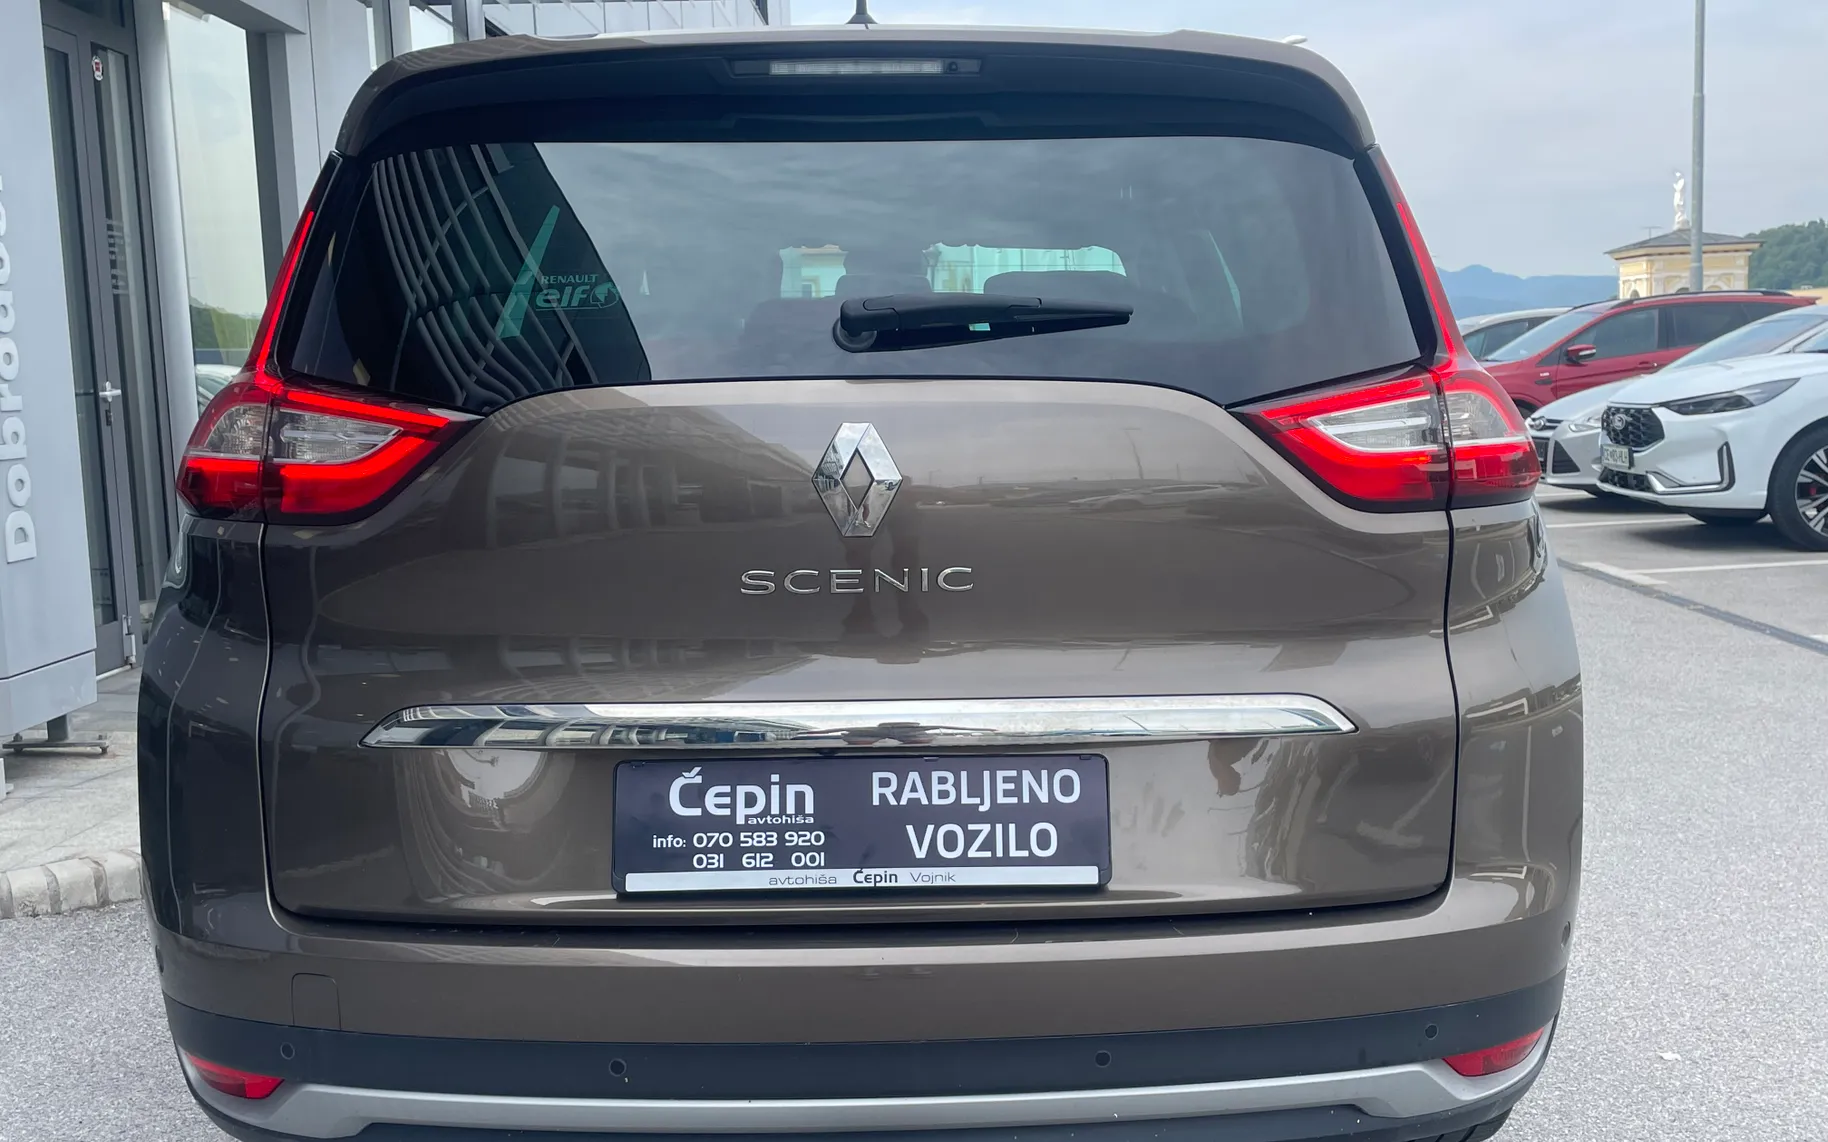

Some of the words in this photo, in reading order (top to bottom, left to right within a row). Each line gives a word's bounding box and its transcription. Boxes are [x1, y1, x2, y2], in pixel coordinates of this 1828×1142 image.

[541, 273, 599, 284] RENAULT
[535, 285, 591, 308] elf
[740, 567, 974, 594] SCENIC
[669, 766, 814, 825] Čepin
[871, 768, 1081, 812] RABLJENO
[747, 814, 815, 825] avtohiša
[652, 834, 687, 848] info:
[693, 832, 733, 848] 070
[739, 832, 778, 847] 583
[784, 831, 826, 846] 920
[905, 822, 1058, 859] VOZILO
[692, 853, 725, 869] 031
[741, 852, 774, 868] 612
[791, 851, 825, 867] 001
[768, 873, 838, 886] avtohiša
[909, 871, 957, 883] Vojnik
